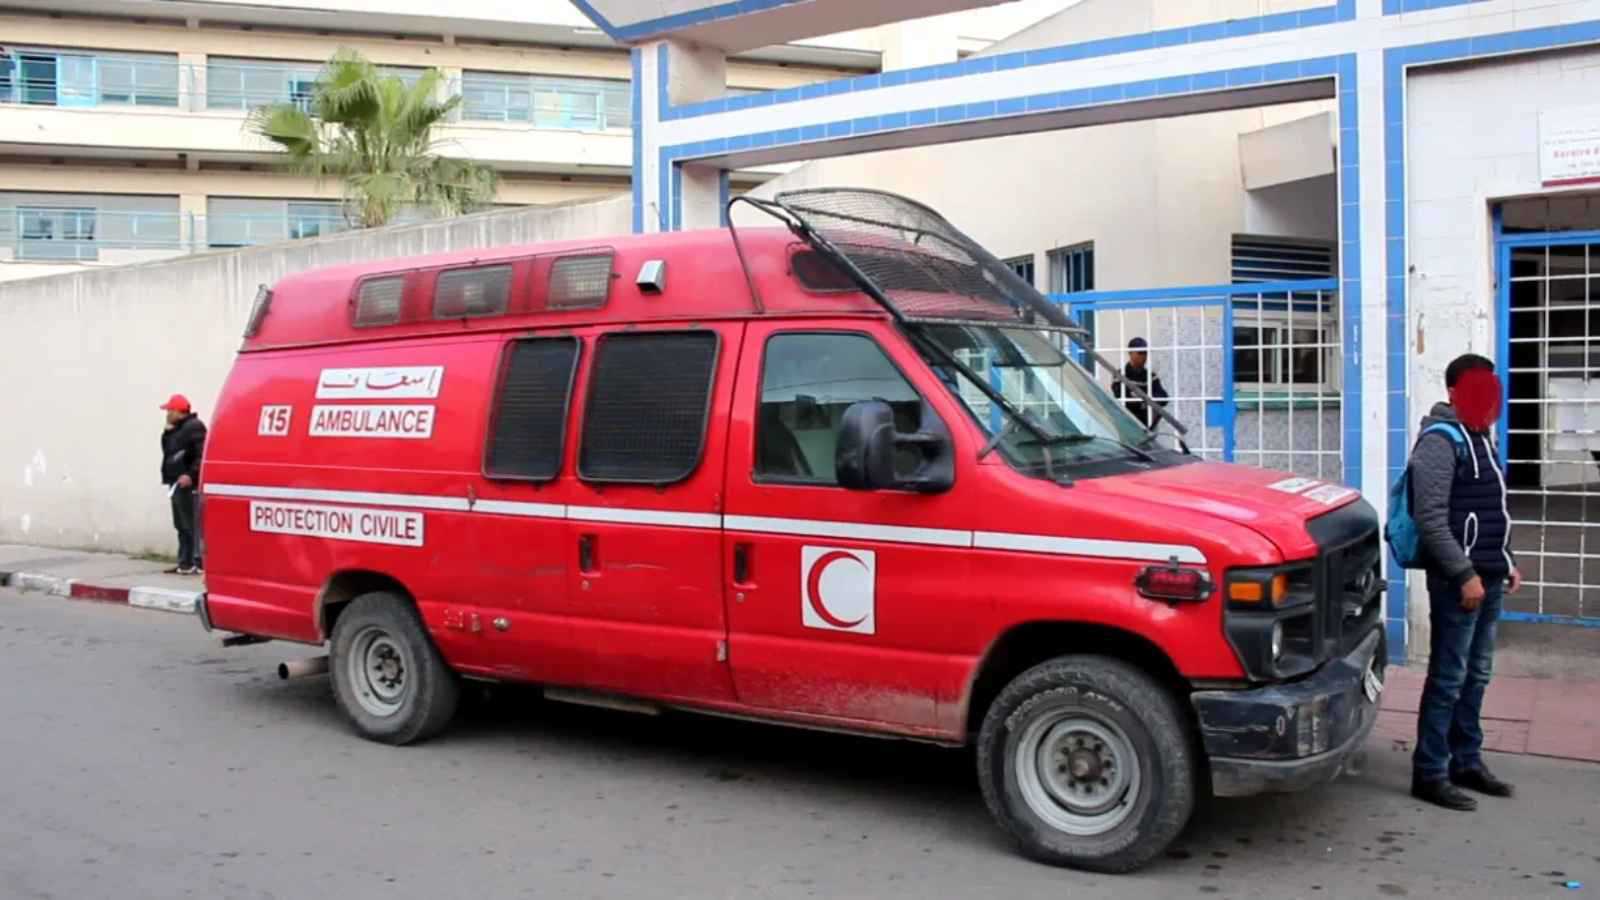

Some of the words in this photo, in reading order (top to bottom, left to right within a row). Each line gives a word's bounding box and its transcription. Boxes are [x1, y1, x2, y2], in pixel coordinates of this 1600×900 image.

[266, 407, 287, 432] 15
[314, 410, 429, 432] AMBULANCE
[254, 506, 353, 533] PROTECTION
[359, 514, 417, 540] CIVILE
